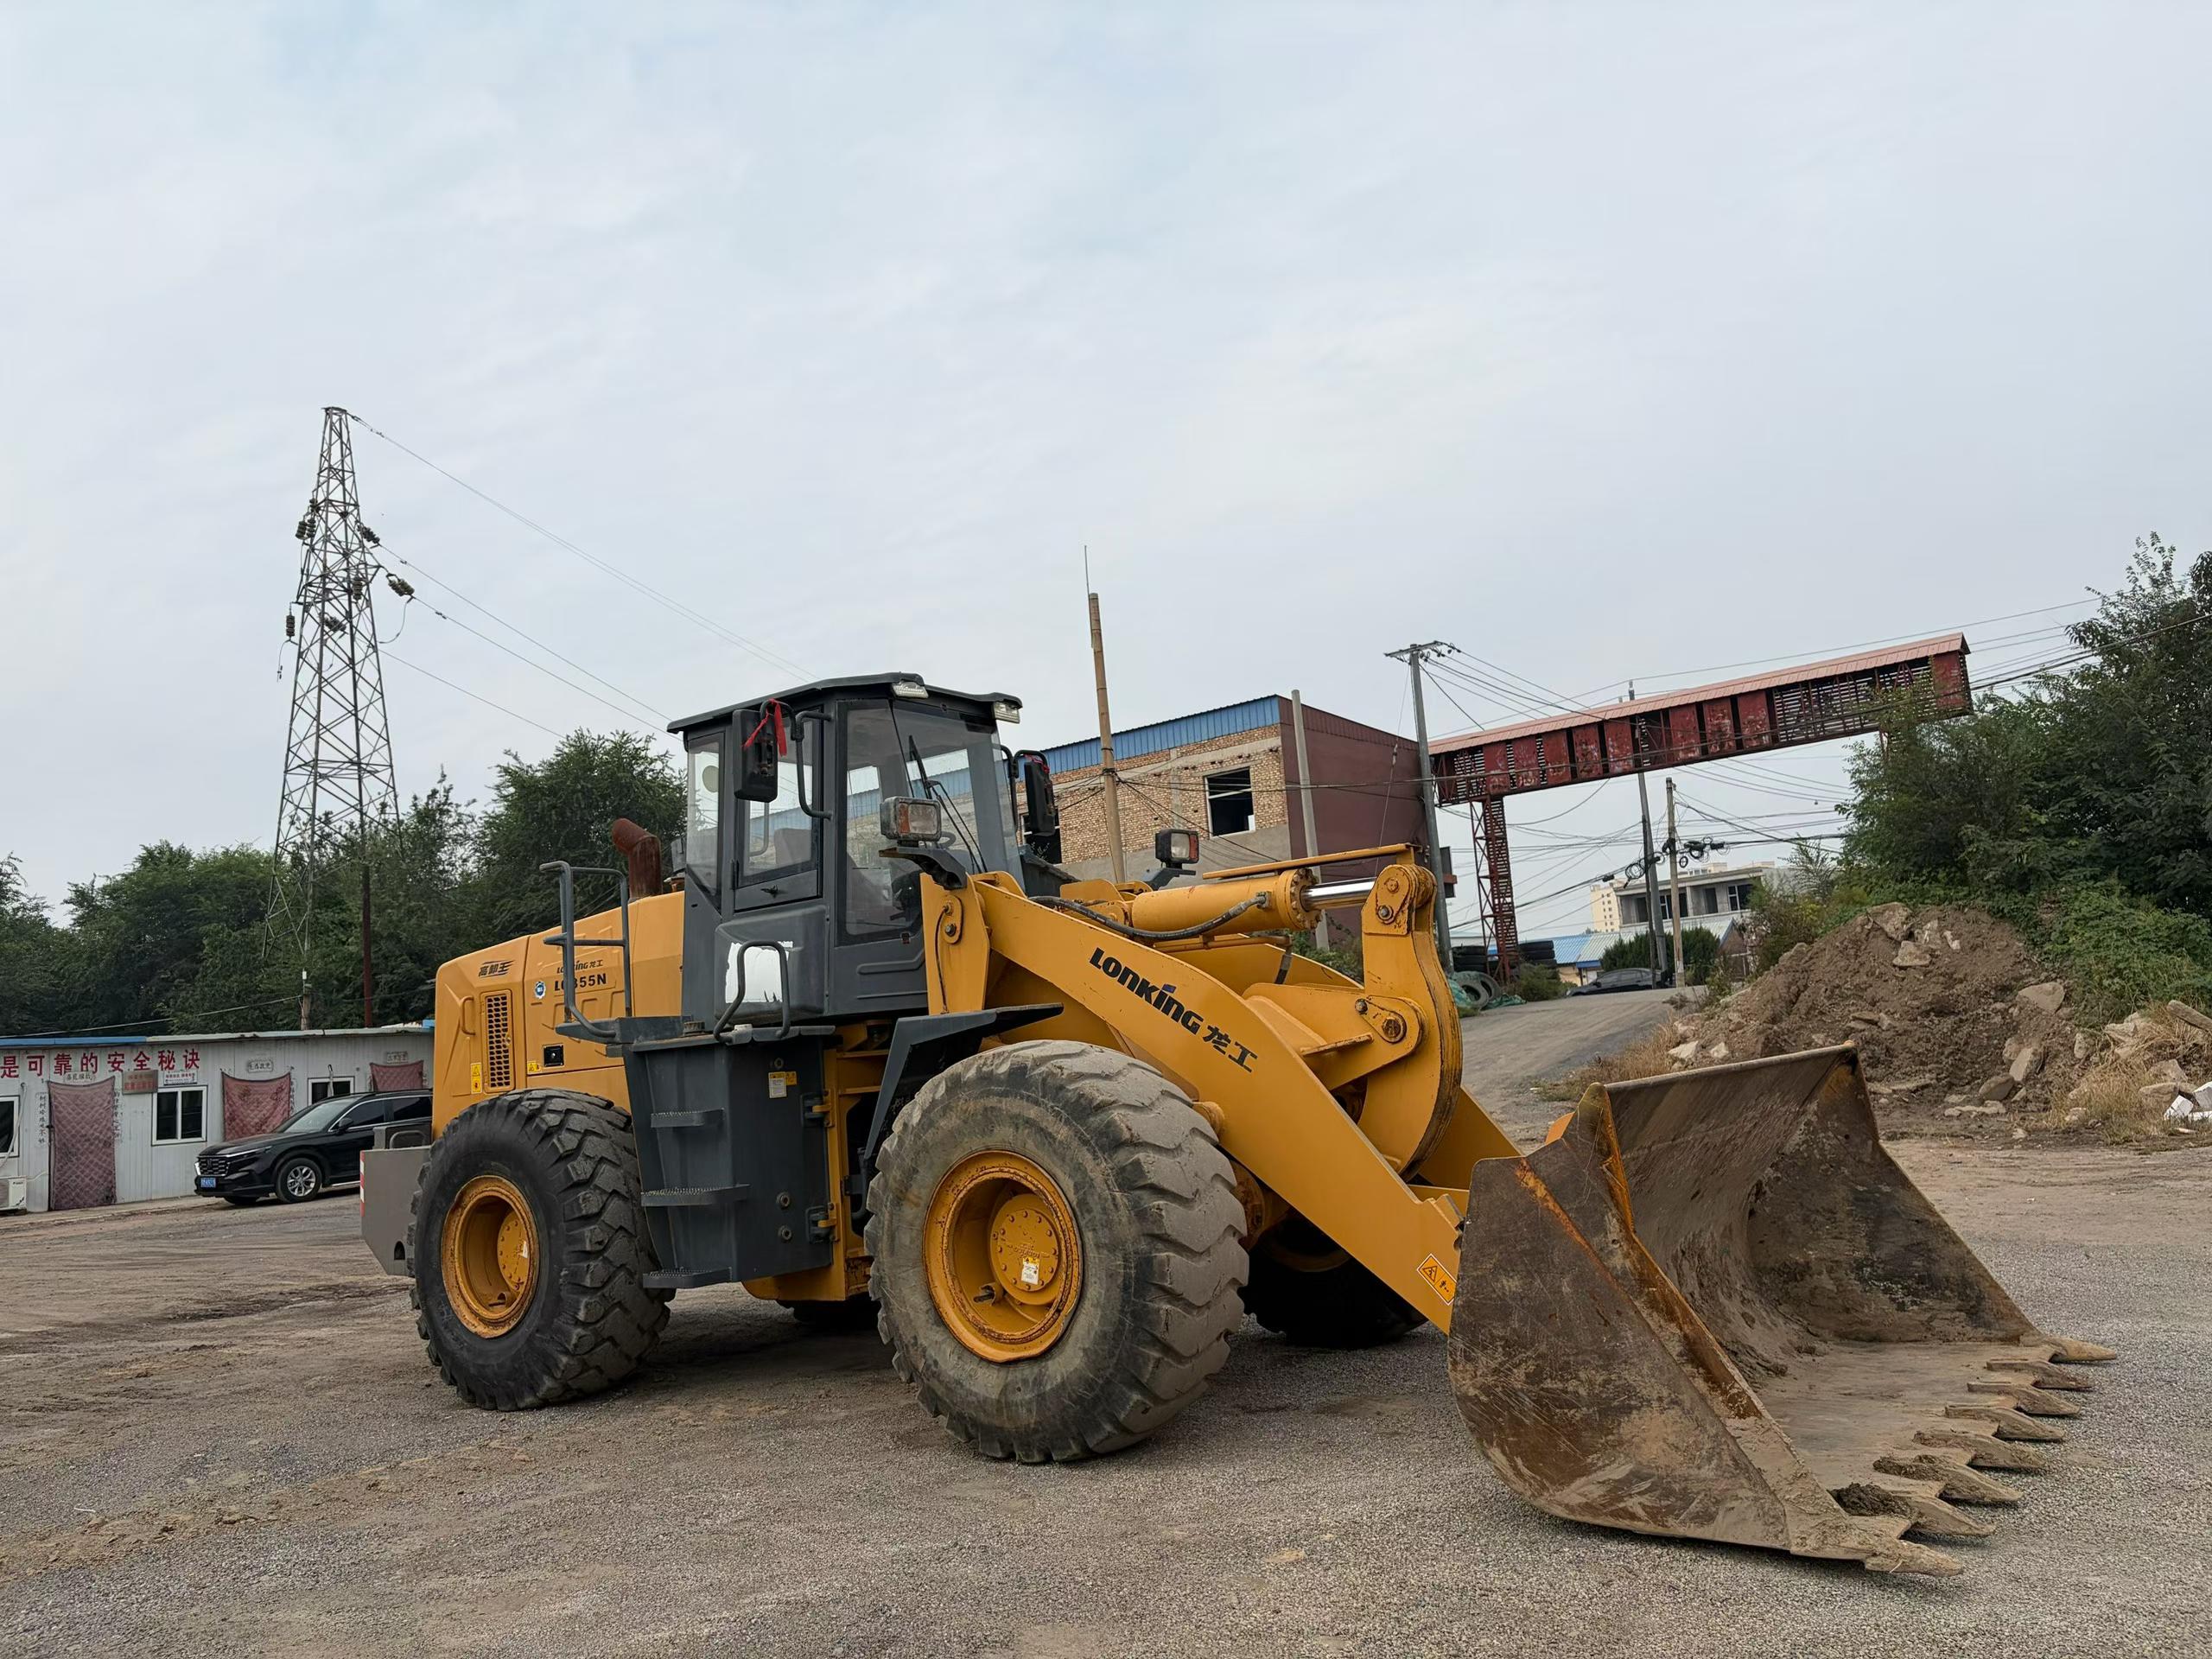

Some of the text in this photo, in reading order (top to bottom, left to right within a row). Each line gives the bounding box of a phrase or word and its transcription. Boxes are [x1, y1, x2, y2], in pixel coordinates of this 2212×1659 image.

[589, 959, 603, 969] 龙工
[0, 1048, 200, 1078] 是可靠的安全秘诀
[1202, 1024, 1259, 1073] 龙工
